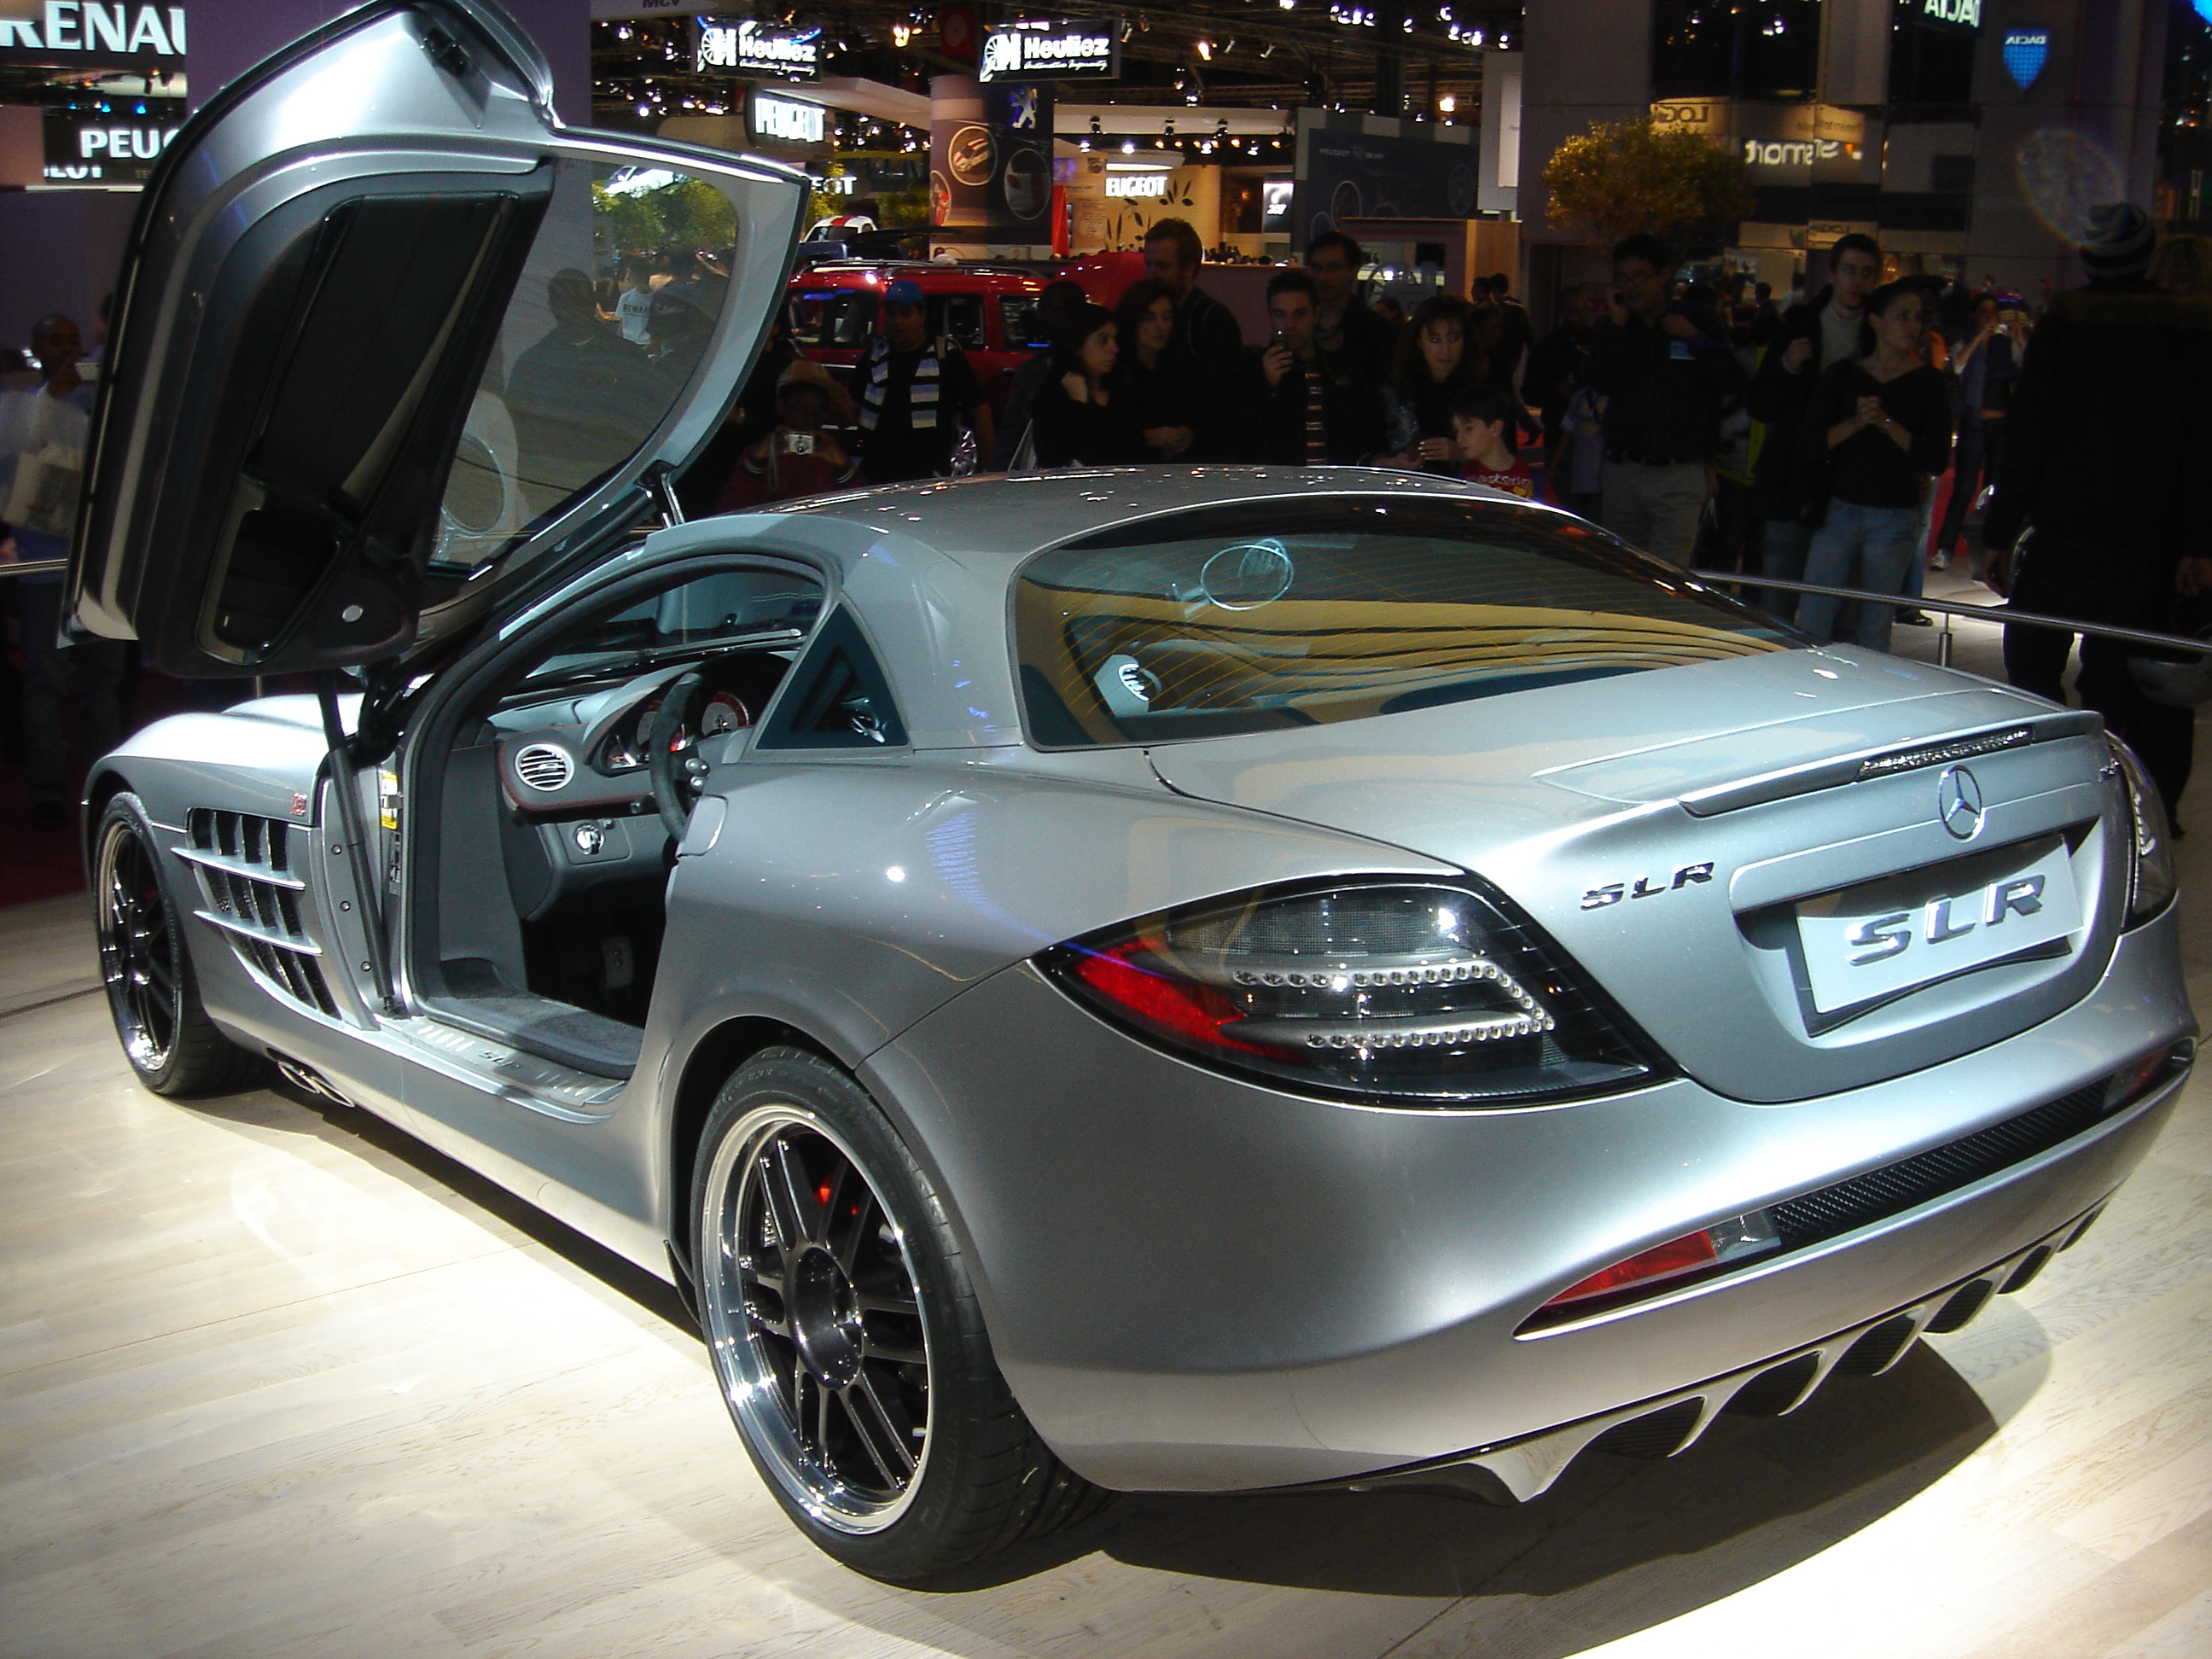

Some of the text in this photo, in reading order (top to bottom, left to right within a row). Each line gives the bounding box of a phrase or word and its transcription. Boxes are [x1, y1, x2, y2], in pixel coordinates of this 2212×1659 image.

[1024, 35, 1110, 59] Heuliez
[1580, 860, 1715, 911] SLR
[1846, 874, 2046, 966] SLR
